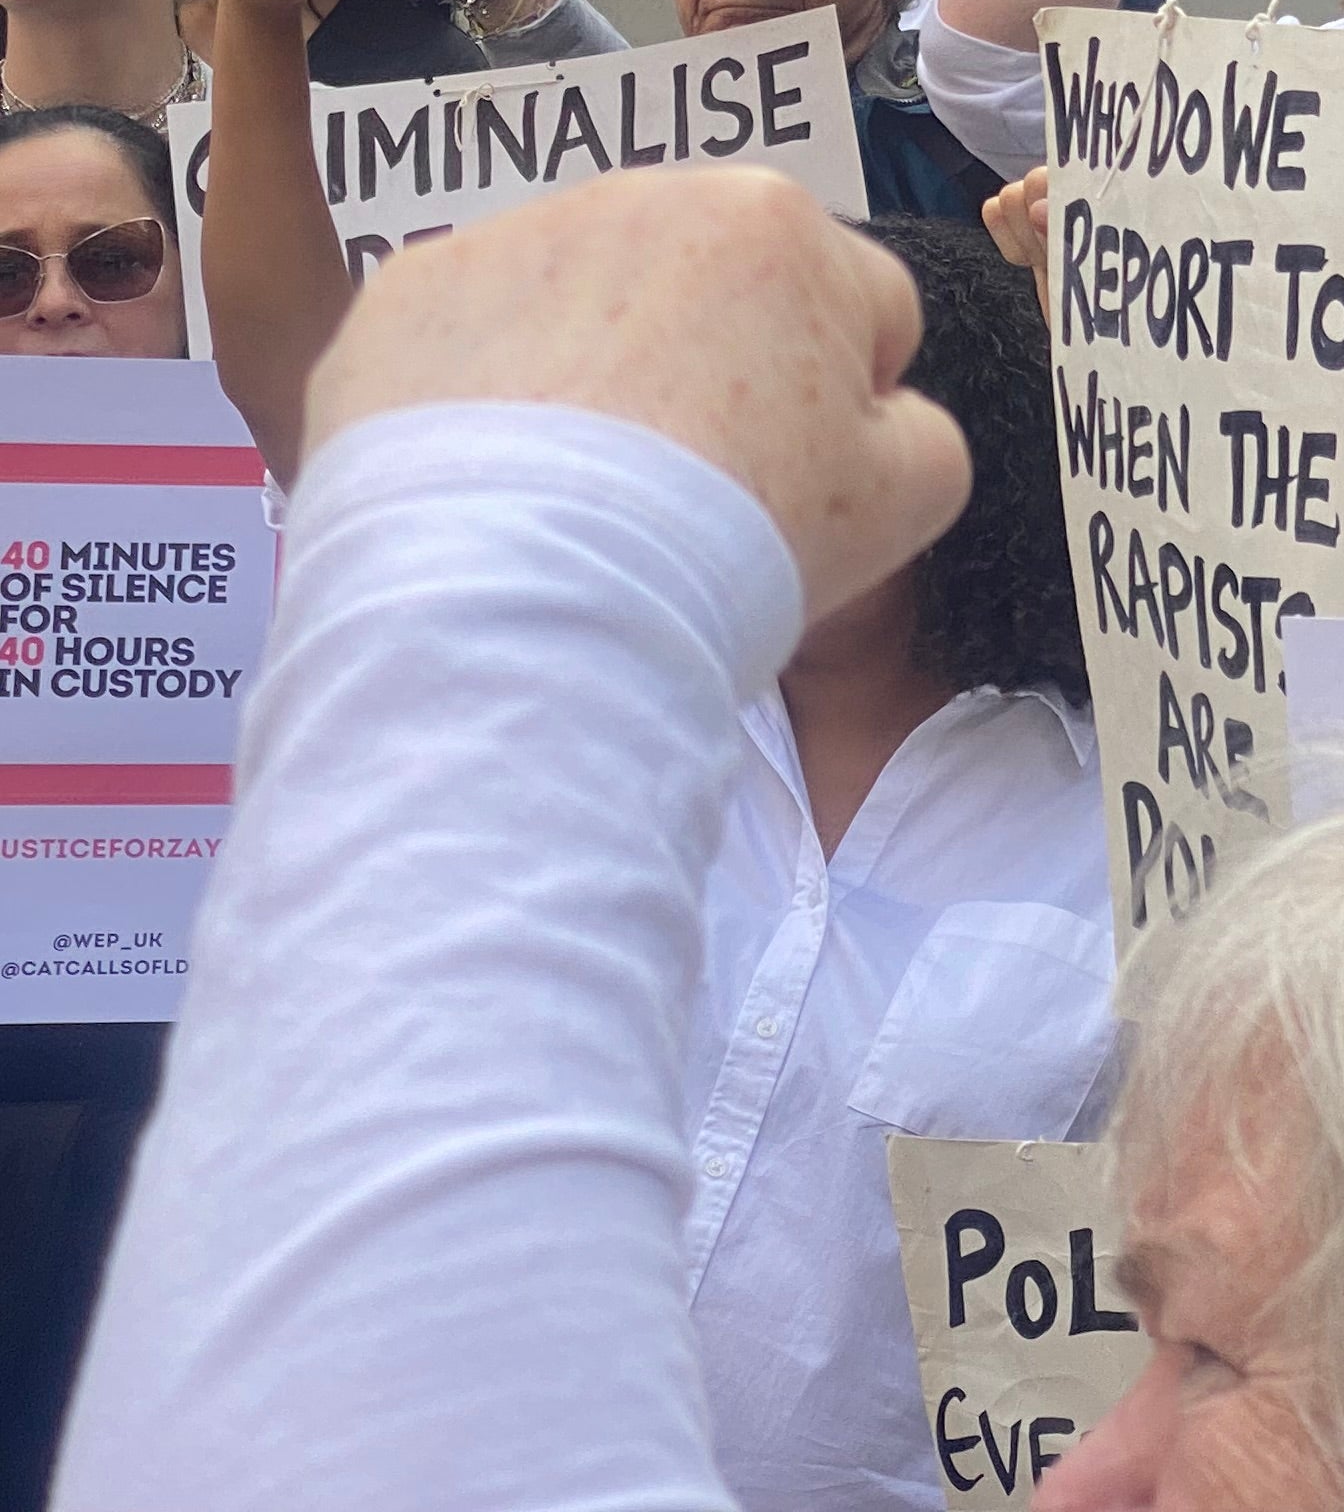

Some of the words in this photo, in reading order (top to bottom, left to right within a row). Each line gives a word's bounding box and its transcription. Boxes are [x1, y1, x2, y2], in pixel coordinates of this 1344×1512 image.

[186, 41, 812, 218] IMINALISE
[1045, 36, 1142, 171] WHO
[1147, 58, 1213, 179] DO
[1222, 60, 1321, 191] WE
[1061, 197, 1254, 362] REPORT
[1057, 365, 1190, 513] WHEN
[1219, 410, 1340, 549] THE
[0, 541, 50, 570] 40
[60, 541, 236, 572] MINUTES
[0, 572, 53, 602] OF
[61, 573, 228, 604] SILENCE
[0, 604, 78, 634] FOR
[0, 636, 45, 666] 40
[55, 637, 195, 666] HOURS
[0, 668, 41, 698] IN
[51, 668, 243, 698] CUSTODY
[53, 932, 163, 952] @WEP_UK
[937, 1387, 1094, 1496] EVE
